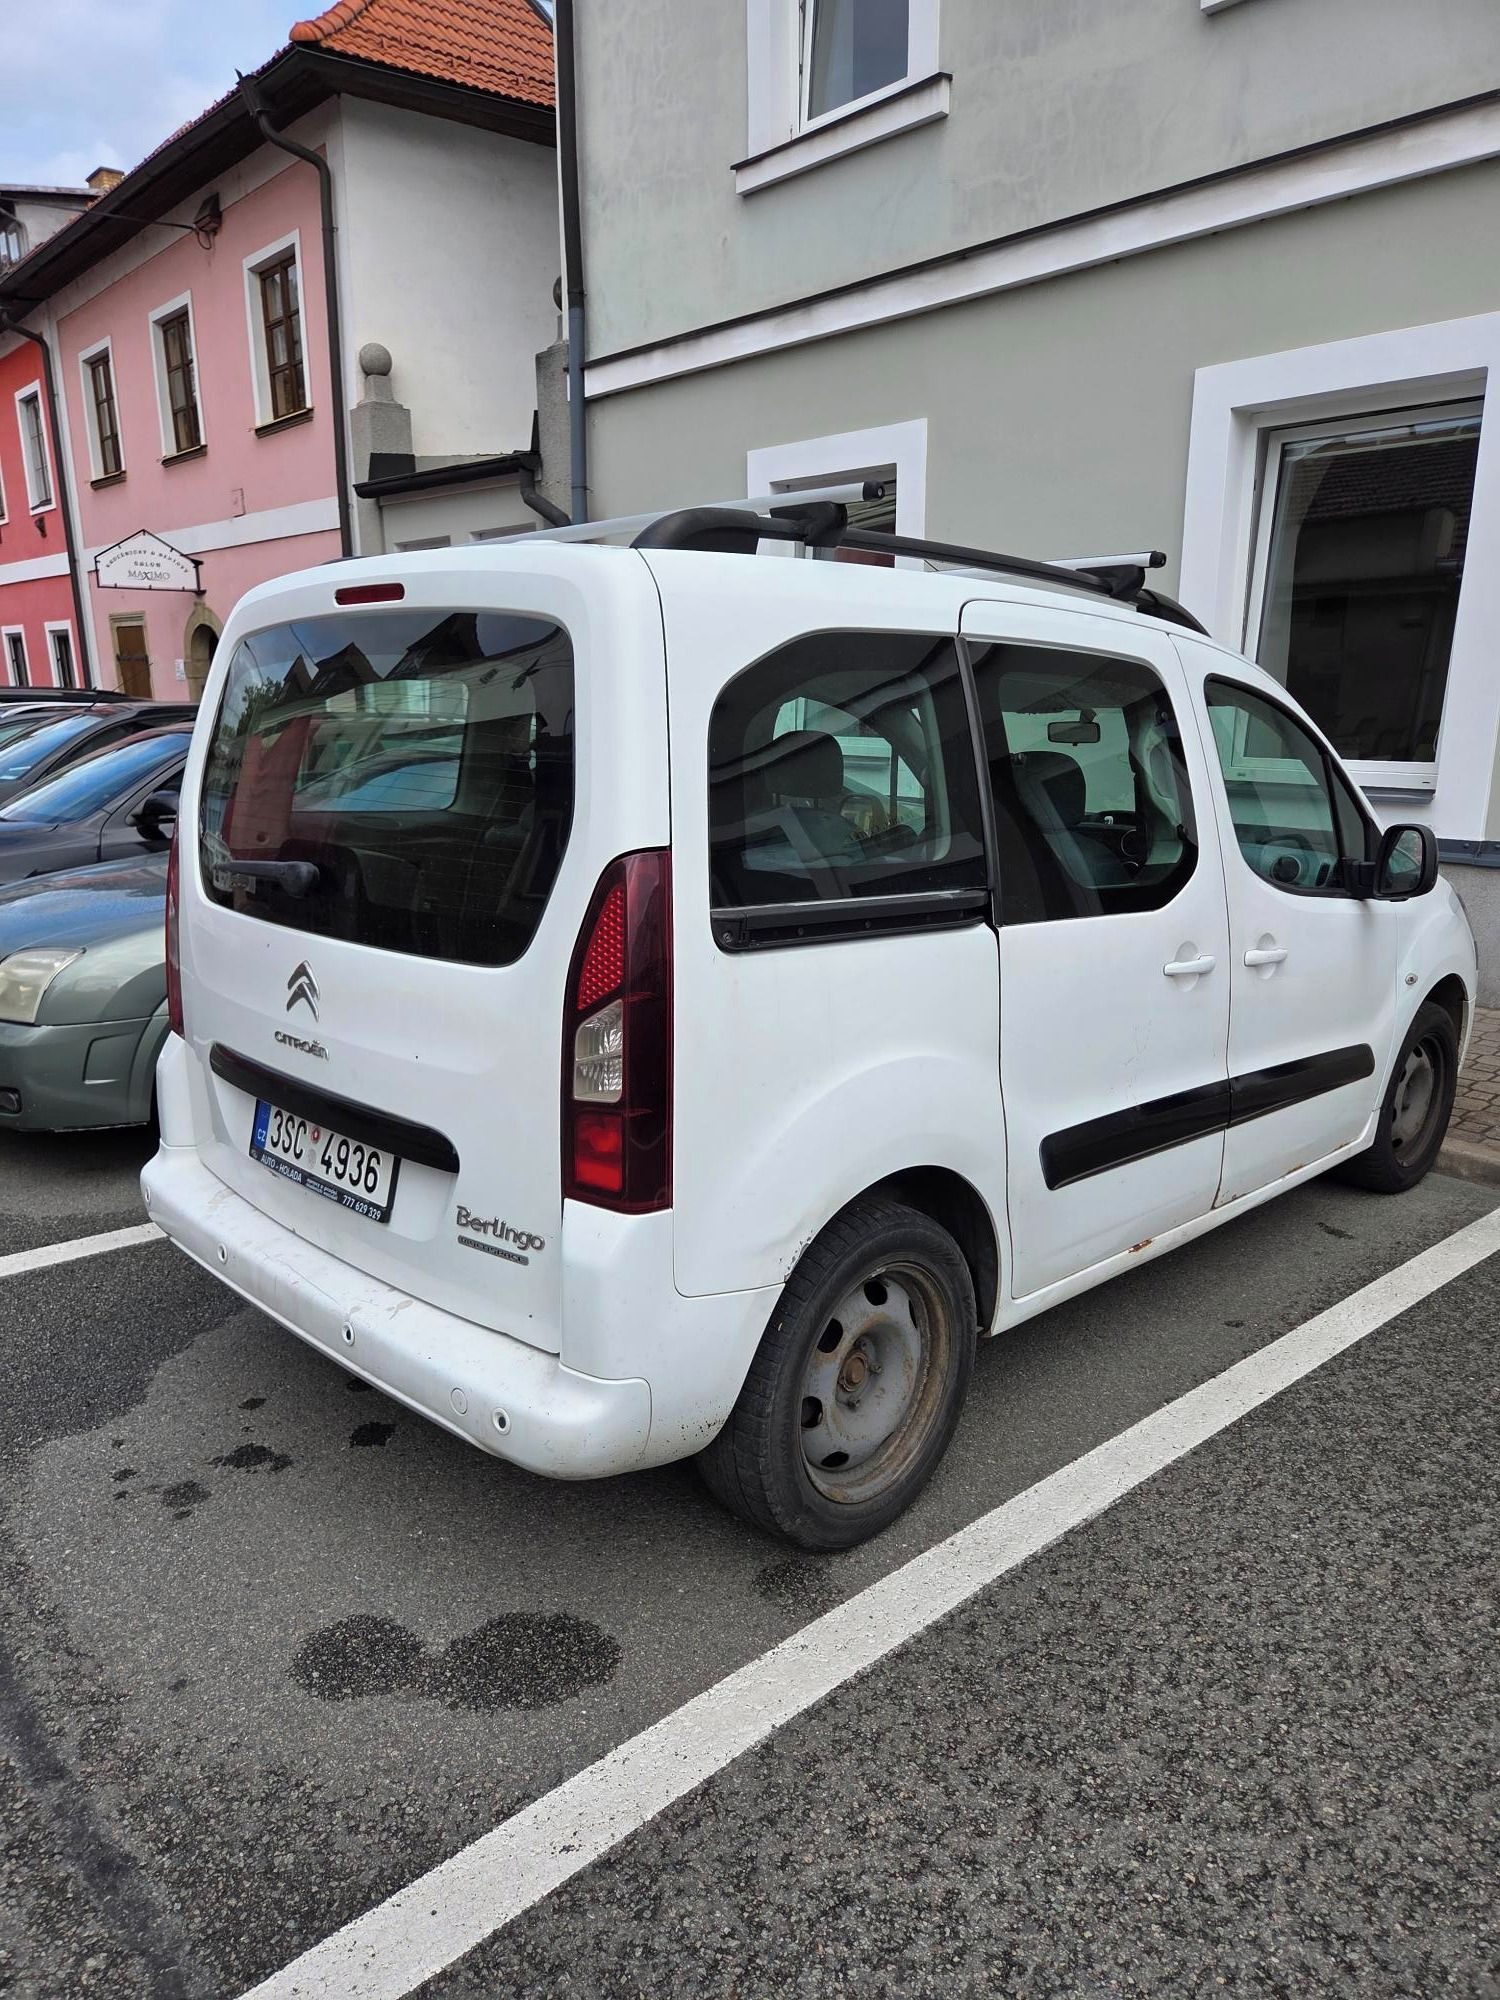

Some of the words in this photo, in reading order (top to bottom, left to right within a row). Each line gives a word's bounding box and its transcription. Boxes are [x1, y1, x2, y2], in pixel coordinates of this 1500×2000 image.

[128, 570, 170, 581] MAXIMO
[257, 1128, 266, 1142] CZ
[270, 1109, 307, 1159] 3SC
[320, 1133, 380, 1193] 4936
[260, 1154, 275, 1168] AUTO
[279, 1163, 302, 1184] HOLADA
[342, 1195, 354, 1207] 777
[355, 1201, 368, 1214] 629
[369, 1207, 382, 1219] 329
[456, 1205, 546, 1250] Berlingo
